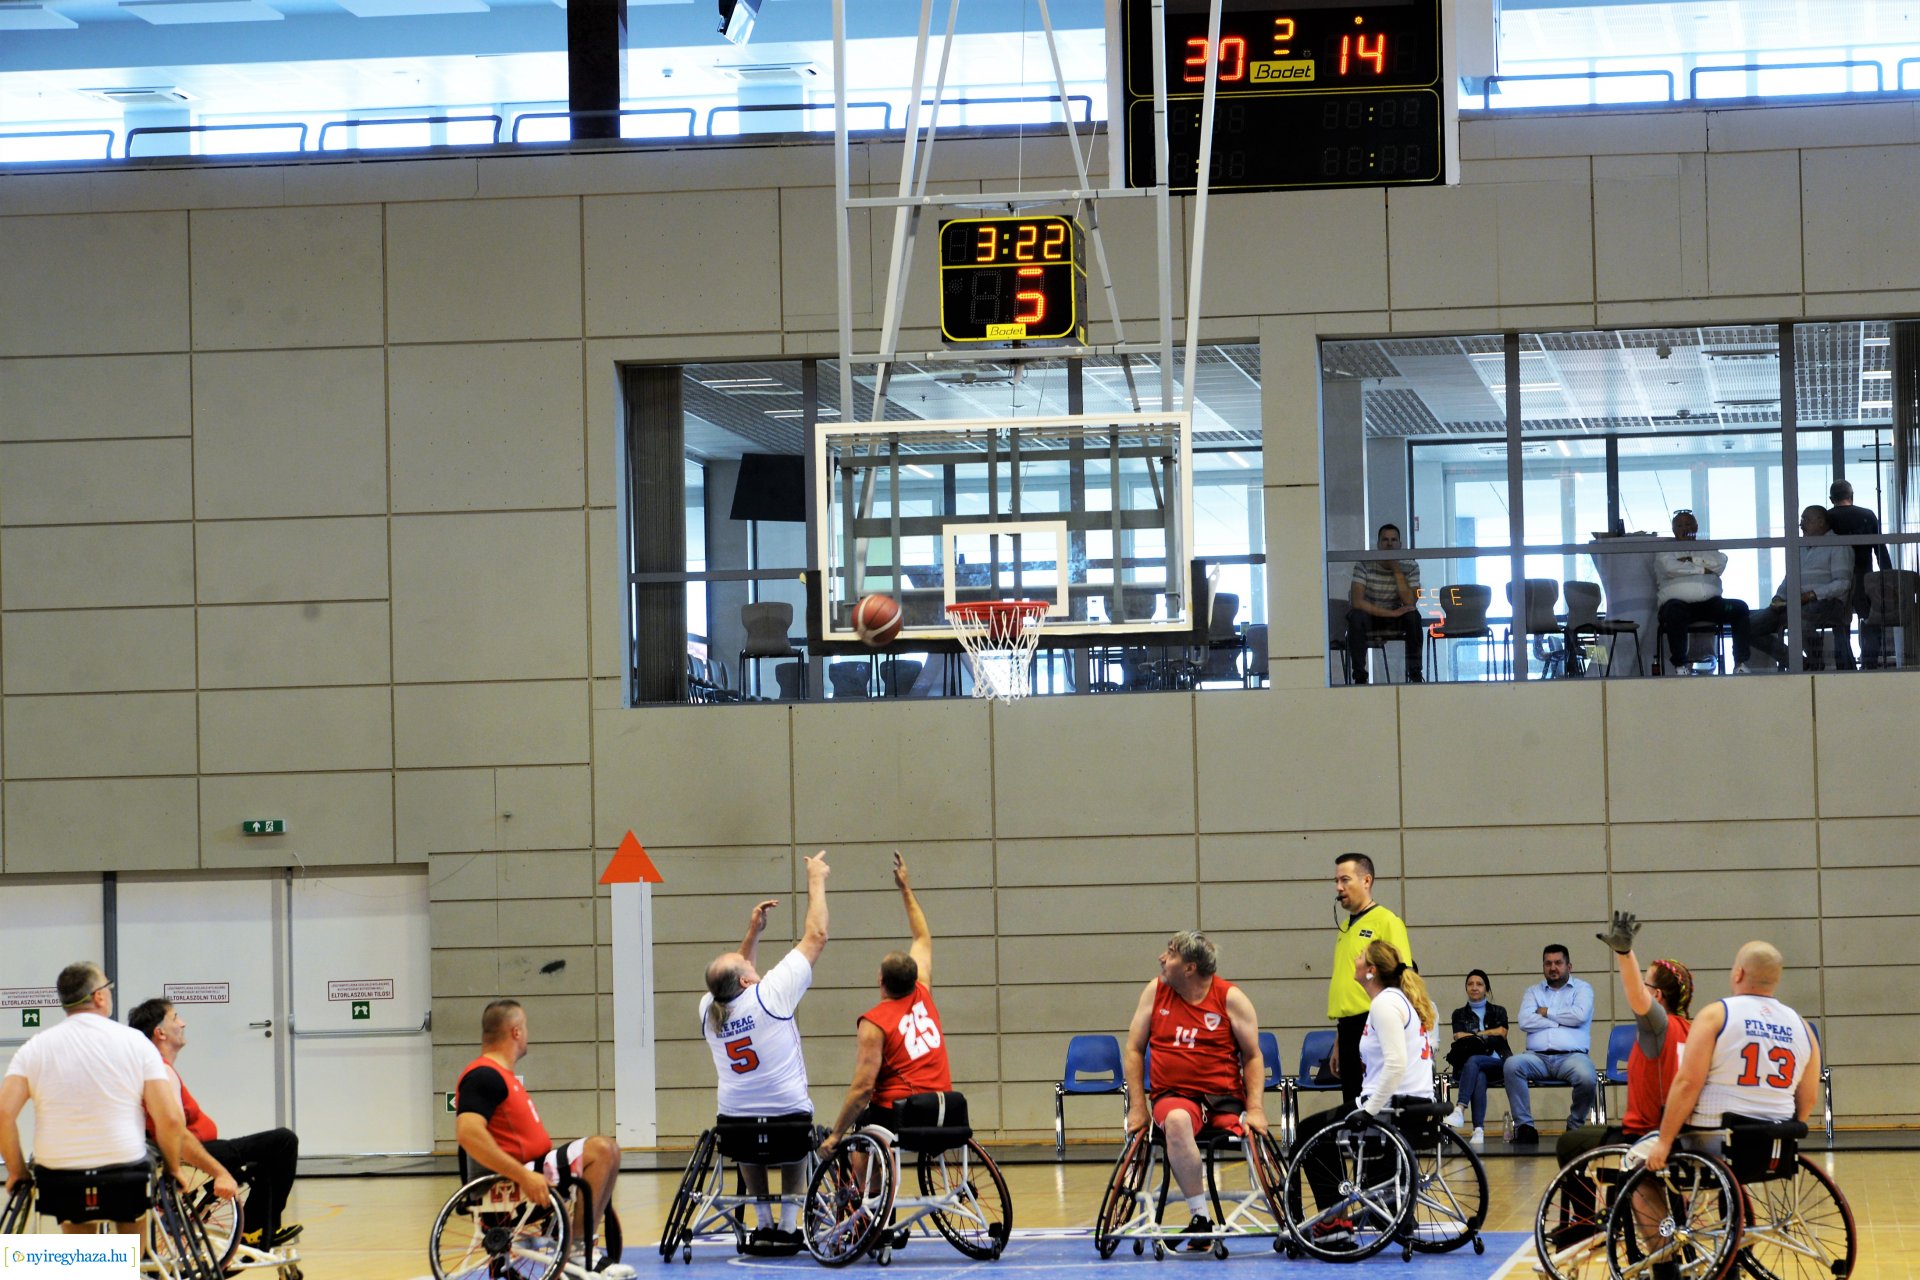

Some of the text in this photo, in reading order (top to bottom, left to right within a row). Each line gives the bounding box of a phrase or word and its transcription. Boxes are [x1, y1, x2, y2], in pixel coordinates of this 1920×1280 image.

[1340, 34, 1384, 75] 14
[1254, 64, 1311, 79] Bodet
[976, 225, 1065, 262] 3:22
[990, 325, 1024, 336] Bodet
[730, 1015, 754, 1030] PEAC
[898, 1000, 941, 1061] 25
[1172, 1026, 1198, 1049] 14
[1744, 1020, 1793, 1037] PTE PEAC
[724, 1036, 760, 1075] 5
[1737, 1042, 1796, 1089] 13
